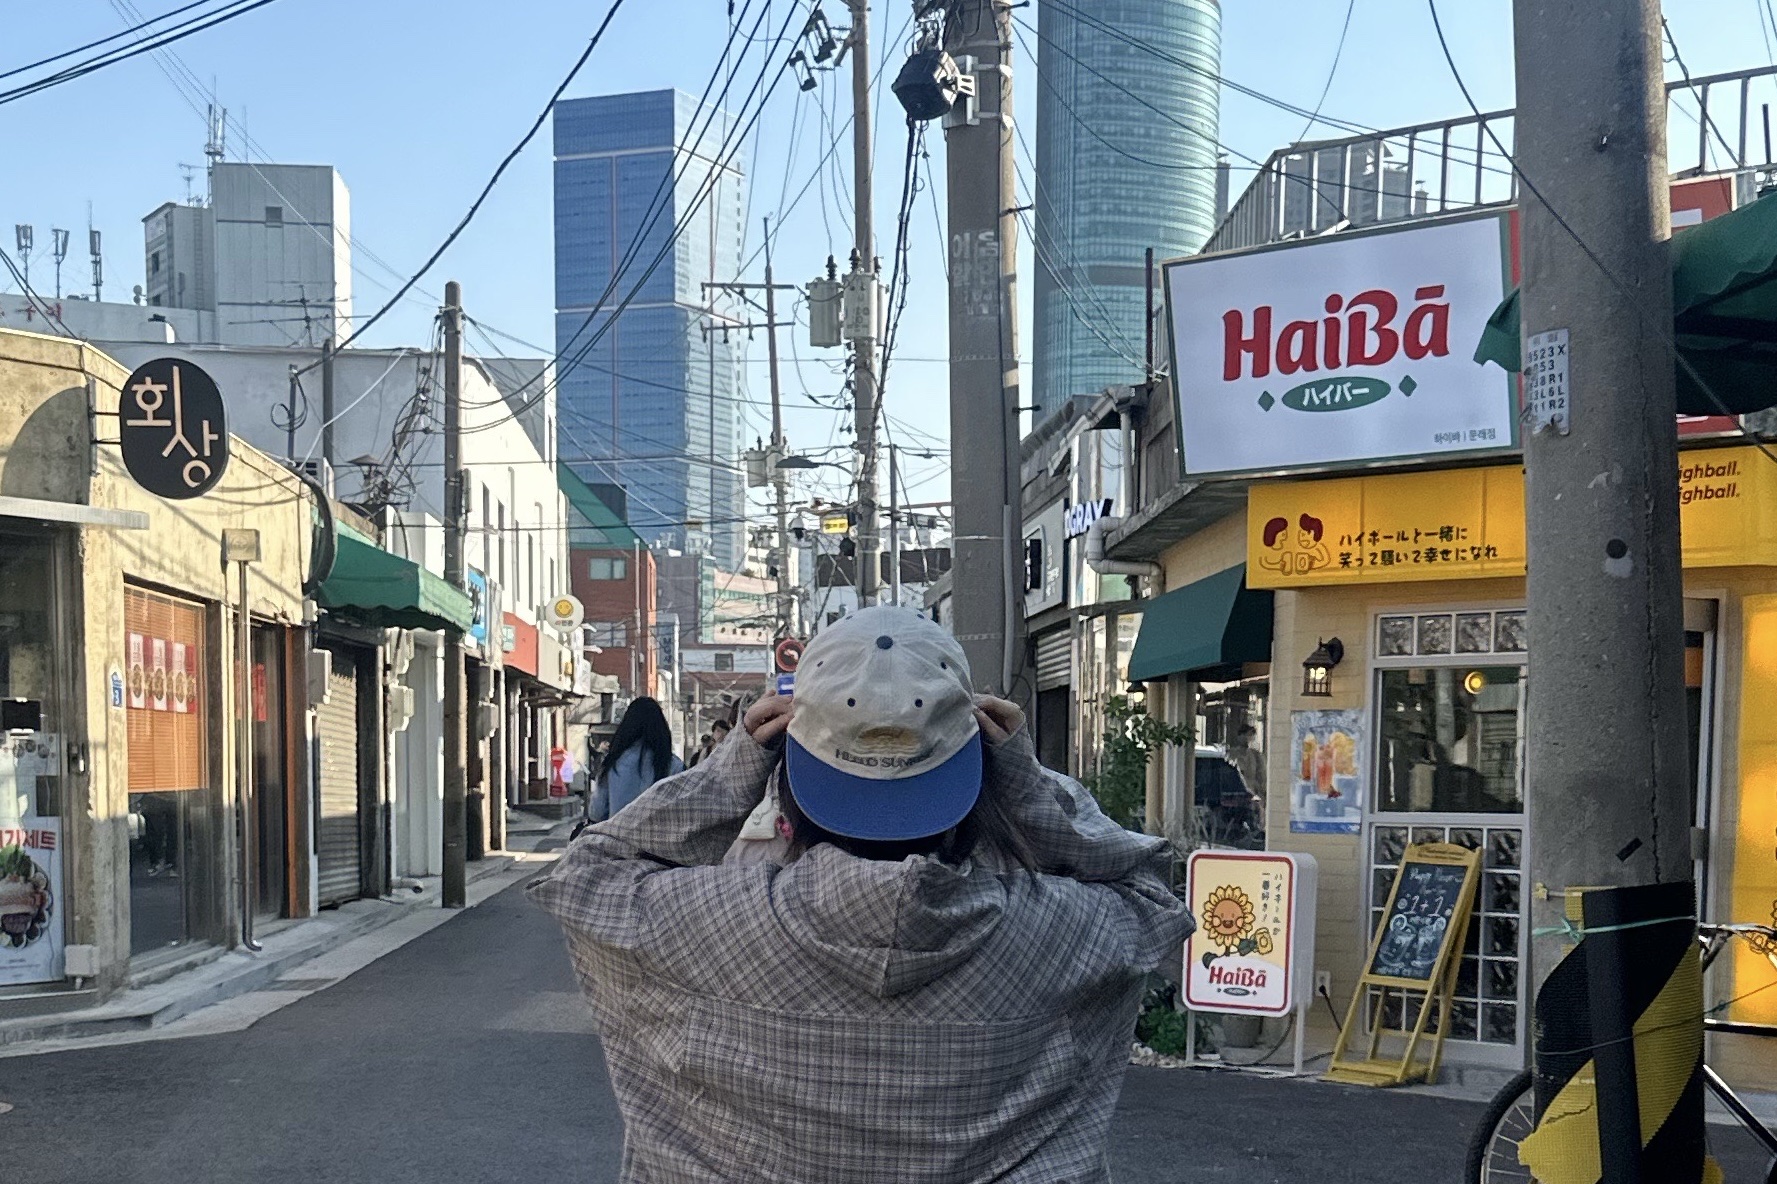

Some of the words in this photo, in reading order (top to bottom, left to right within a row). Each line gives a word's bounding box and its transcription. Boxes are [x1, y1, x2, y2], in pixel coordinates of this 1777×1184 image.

[1223, 285, 1450, 381] HaiBā
[1679, 461, 1740, 483] ighball.
[0, 829, 56, 851] 기세트
